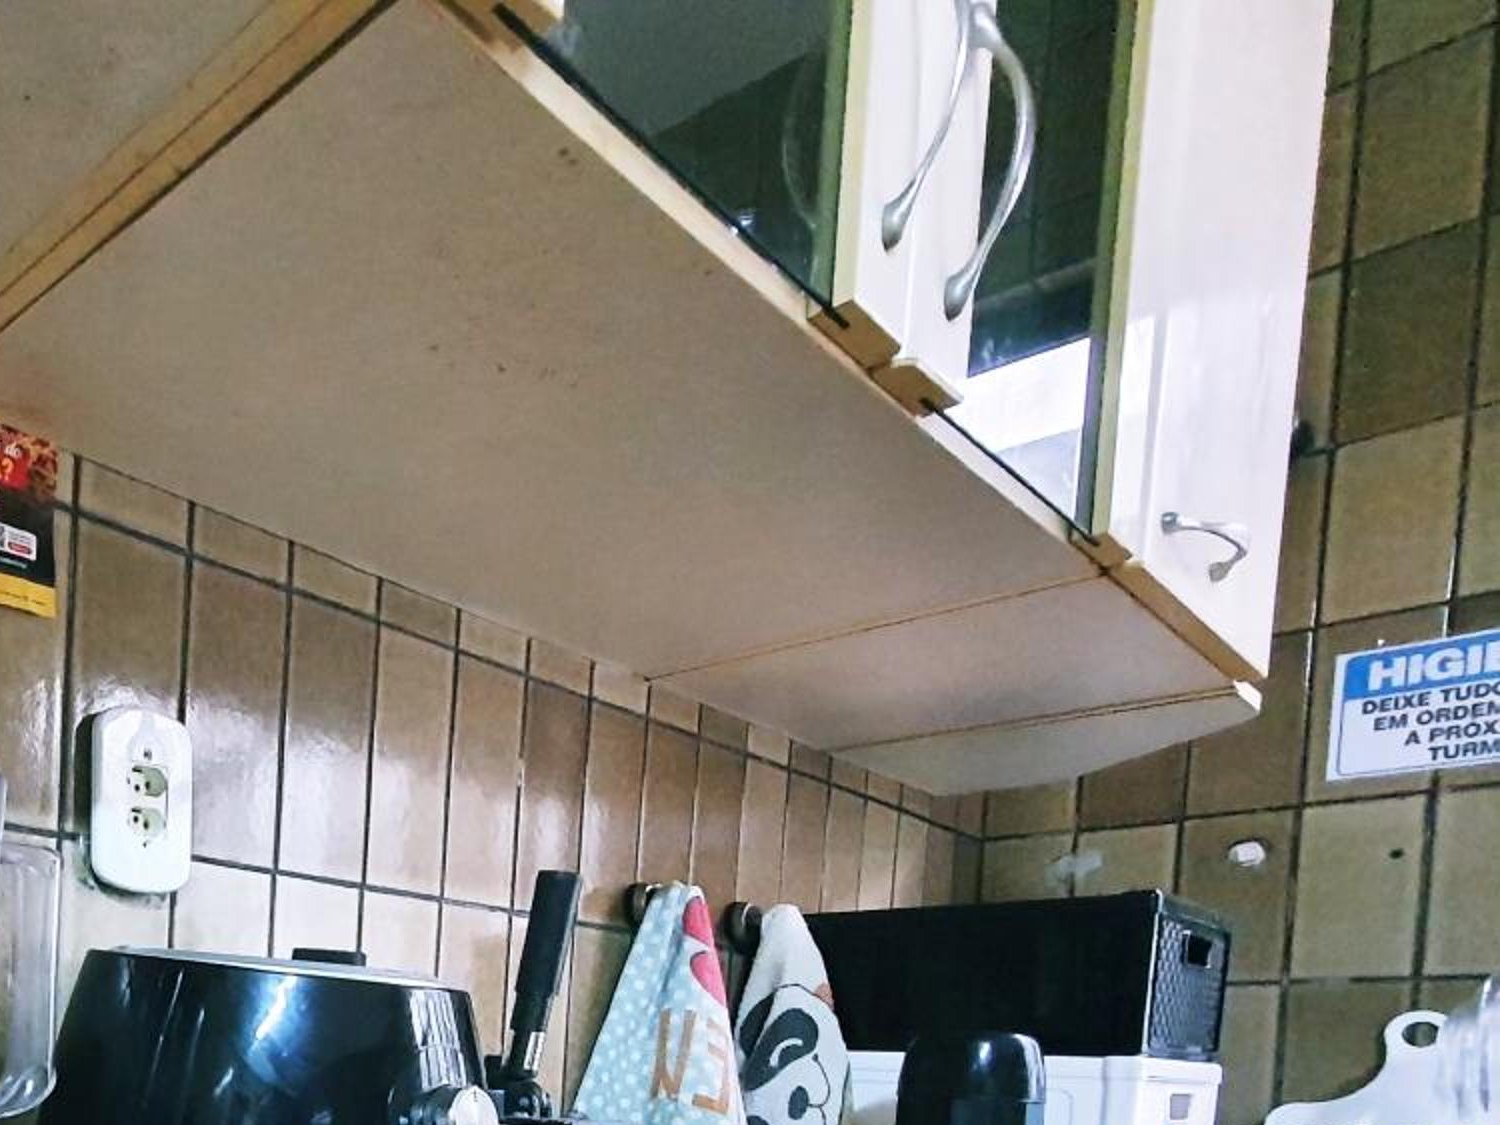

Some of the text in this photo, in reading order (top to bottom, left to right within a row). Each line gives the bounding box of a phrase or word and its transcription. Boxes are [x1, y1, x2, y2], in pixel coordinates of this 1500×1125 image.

[1362, 691, 1431, 715] DEIXE
[1373, 713, 1408, 731] EM
[1404, 730, 1420, 746] A
